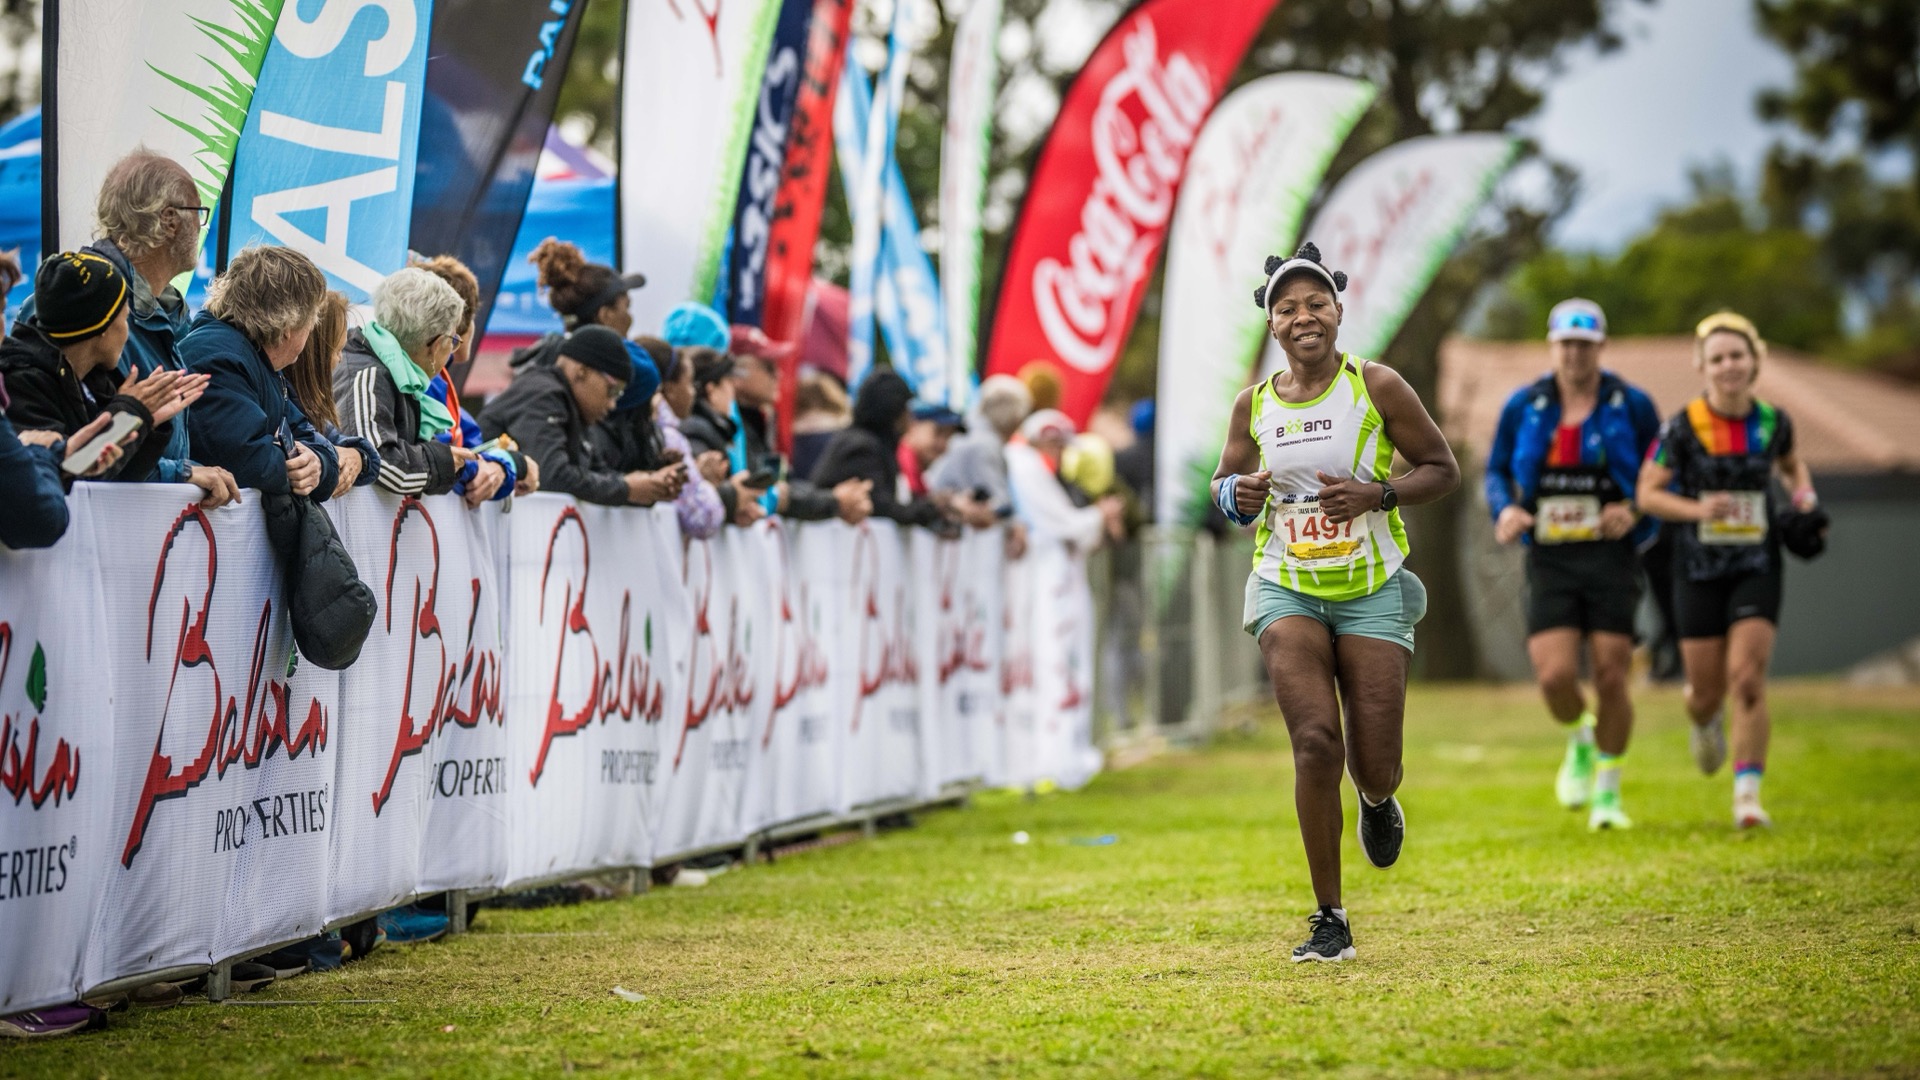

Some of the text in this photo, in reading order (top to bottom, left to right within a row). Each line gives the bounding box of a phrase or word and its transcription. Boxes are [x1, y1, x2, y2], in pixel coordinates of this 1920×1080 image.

[522, 0, 574, 90] PA
[1276, 418, 1332, 438] exxaro
[1303, 495, 1320, 503] 202
[1284, 515, 1354, 543] 1497
